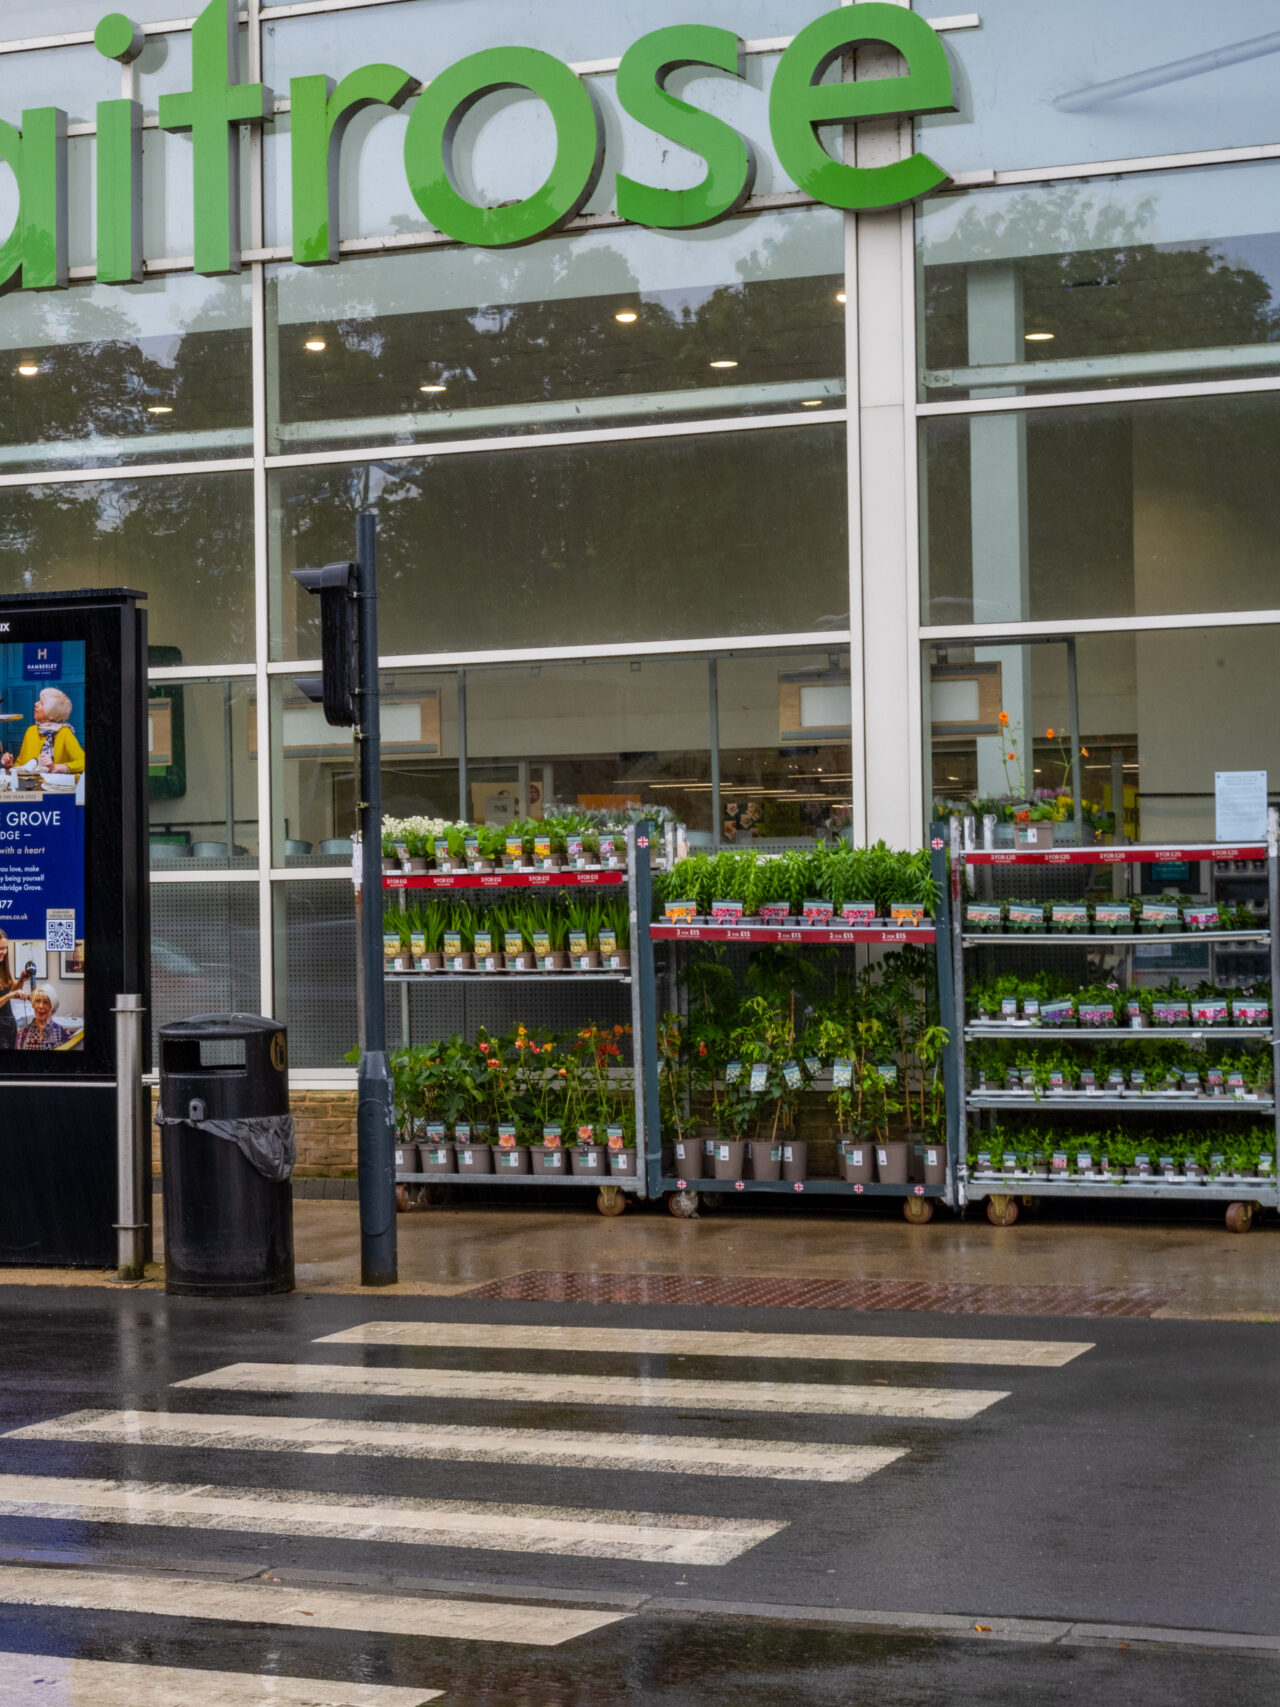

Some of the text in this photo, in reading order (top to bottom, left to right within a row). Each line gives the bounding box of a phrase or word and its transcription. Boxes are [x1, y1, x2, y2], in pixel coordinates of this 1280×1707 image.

[37, 648, 48, 660] H
[6, 811, 61, 827] GROVE
[0, 845, 15, 855] with
[24, 845, 45, 855] heart
[9, 865, 23, 873] love,
[24, 864, 40, 872] make
[5, 875, 21, 883] being
[22, 874, 45, 883] yourself
